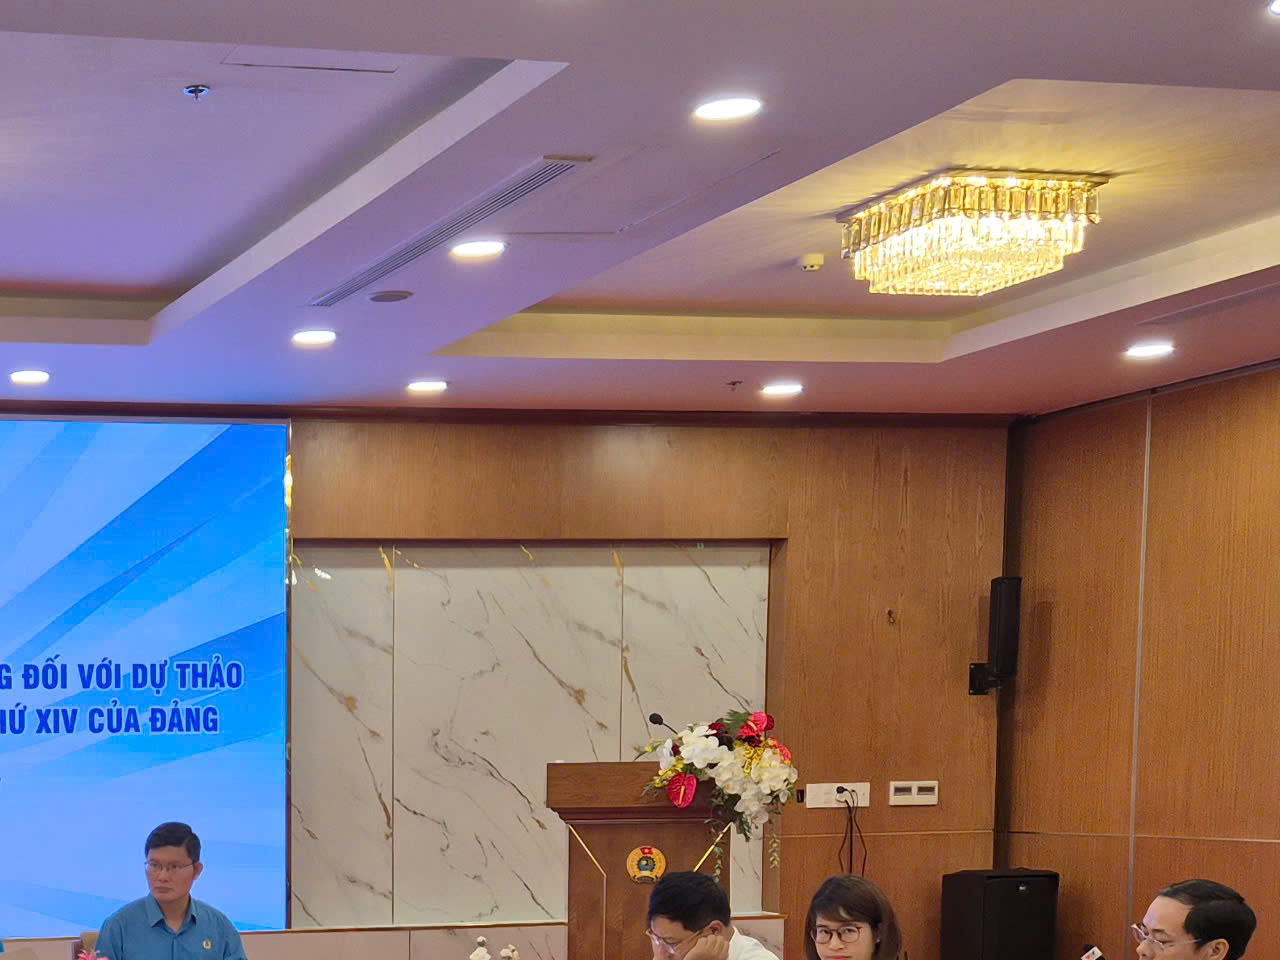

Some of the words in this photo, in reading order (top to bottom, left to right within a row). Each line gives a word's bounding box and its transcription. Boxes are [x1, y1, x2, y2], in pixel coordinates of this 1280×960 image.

[21, 653, 68, 690] ĐỐI
[77, 657, 122, 690] VỚI
[131, 659, 169, 695] DỰ
[175, 654, 243, 689] THẢO
[35, 708, 78, 734] XIV
[88, 699, 141, 734] CỦA
[148, 700, 219, 734] ĐẢNG
